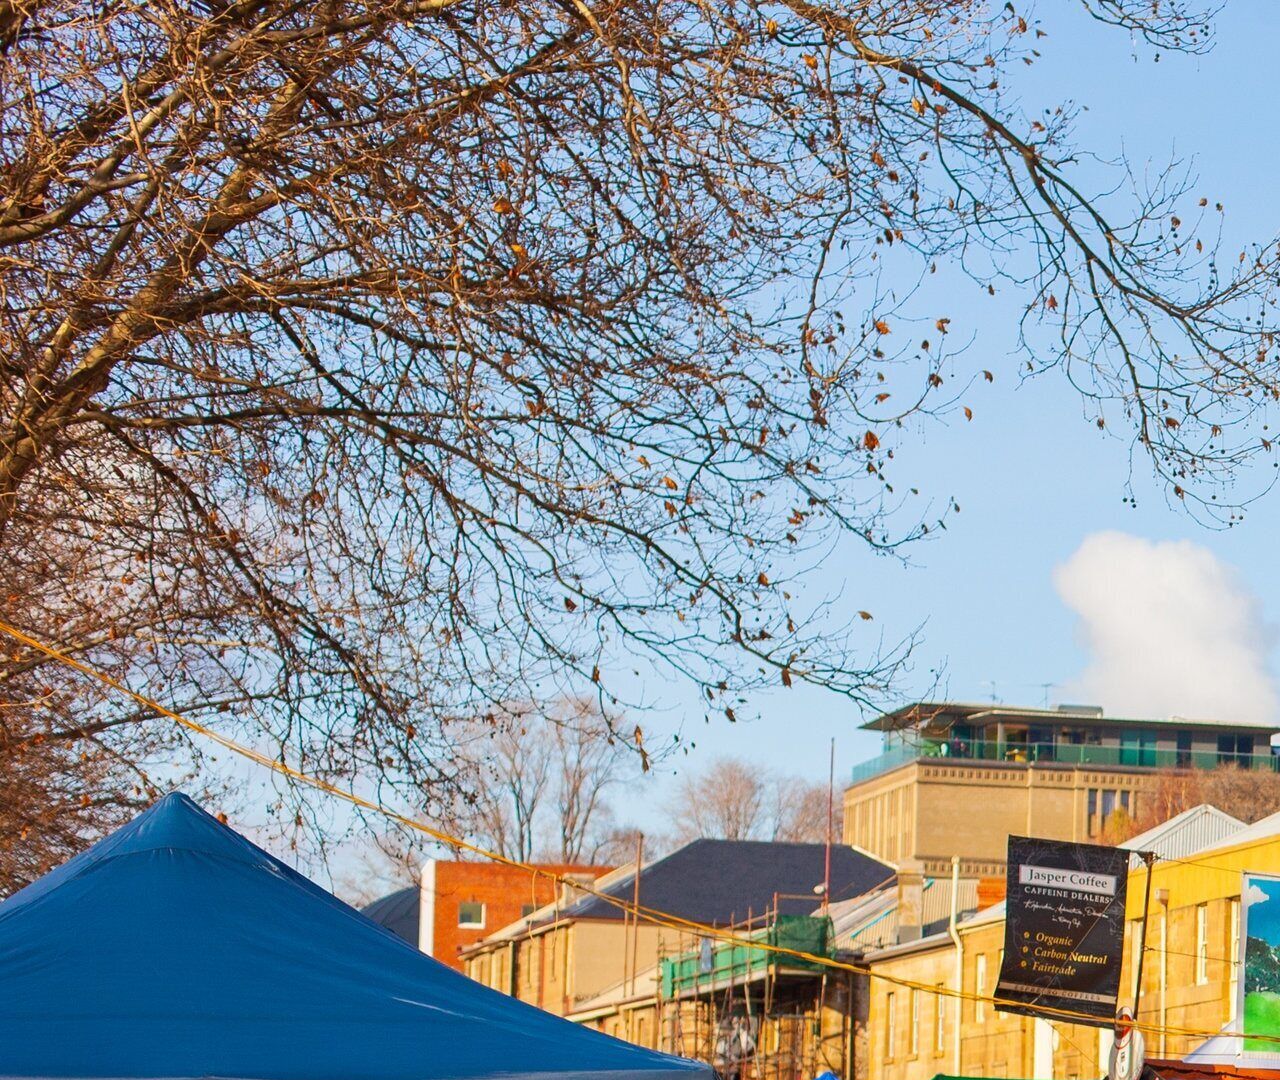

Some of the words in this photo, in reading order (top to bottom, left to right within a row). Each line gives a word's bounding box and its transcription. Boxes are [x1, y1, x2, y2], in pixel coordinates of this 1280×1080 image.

[1028, 869, 1067, 884] Jasper
[1069, 874, 1108, 889] Coffee
[1024, 886, 1068, 898] CAFFEINE
[1036, 932, 1073, 946] Organic
[1034, 947, 1067, 960] Carbon
[1069, 951, 1108, 965] Neutral
[1032, 961, 1077, 976] Fairtrade
